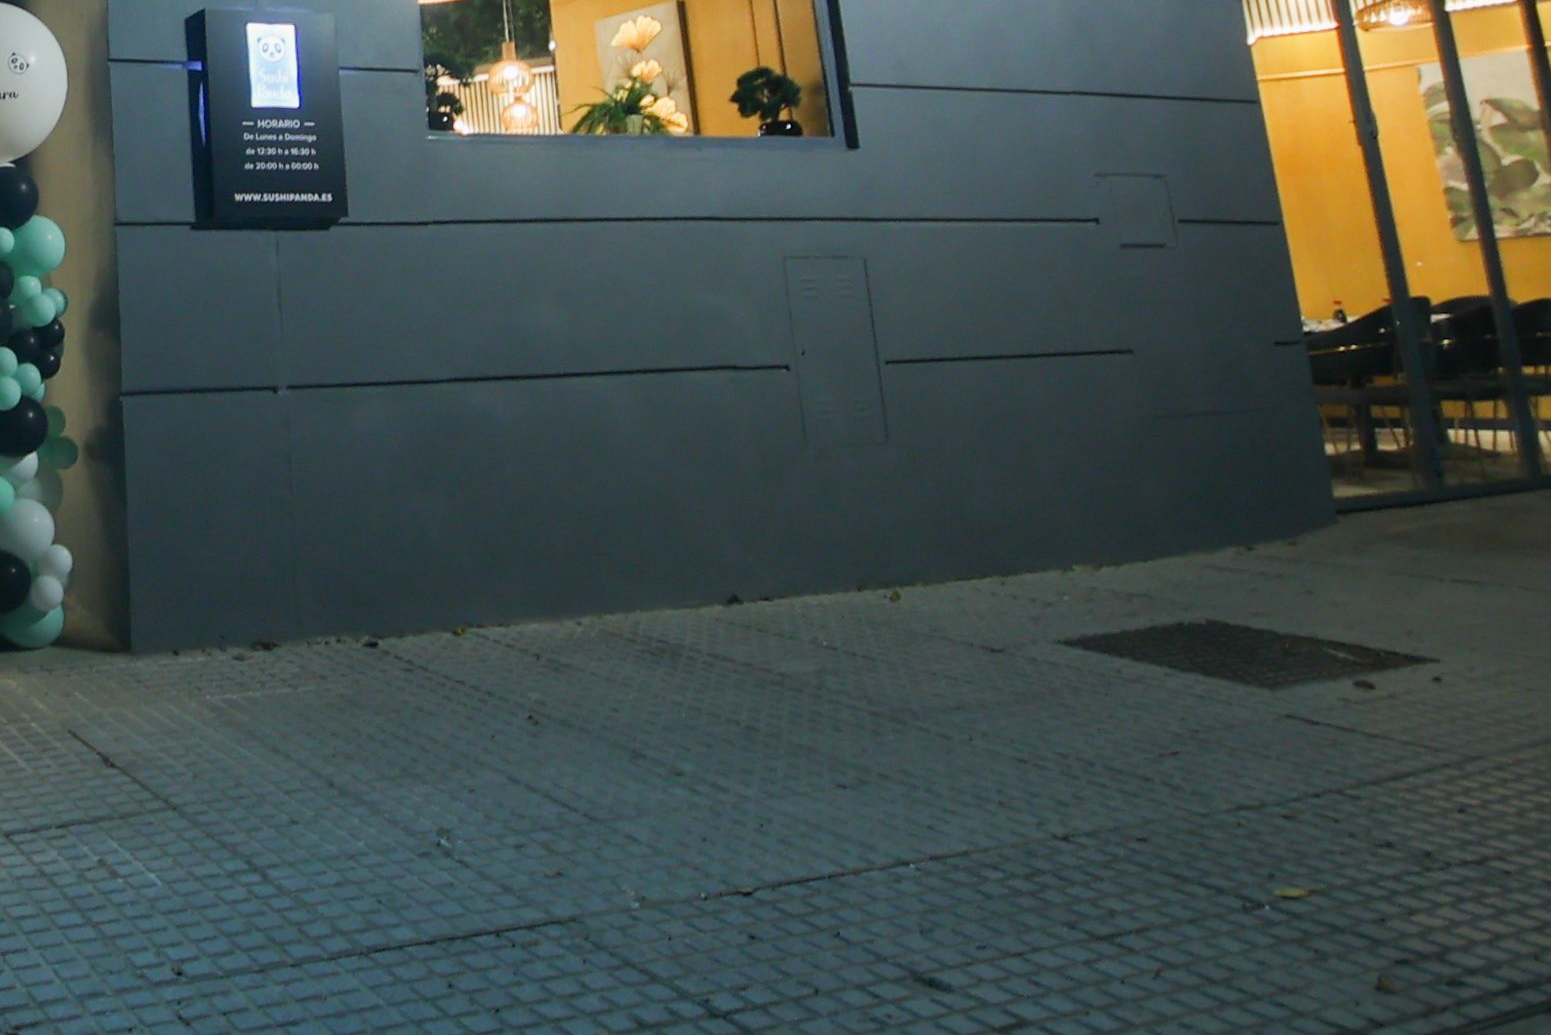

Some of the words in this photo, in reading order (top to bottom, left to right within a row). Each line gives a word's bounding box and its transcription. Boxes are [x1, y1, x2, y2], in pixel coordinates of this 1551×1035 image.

[257, 119, 300, 129] HORARIO
[243, 132, 254, 141] De
[255, 132, 277, 141] Lunes
[284, 132, 317, 143] Domingo
[234, 193, 333, 202] WWW.SUSHIPANDA.ES
